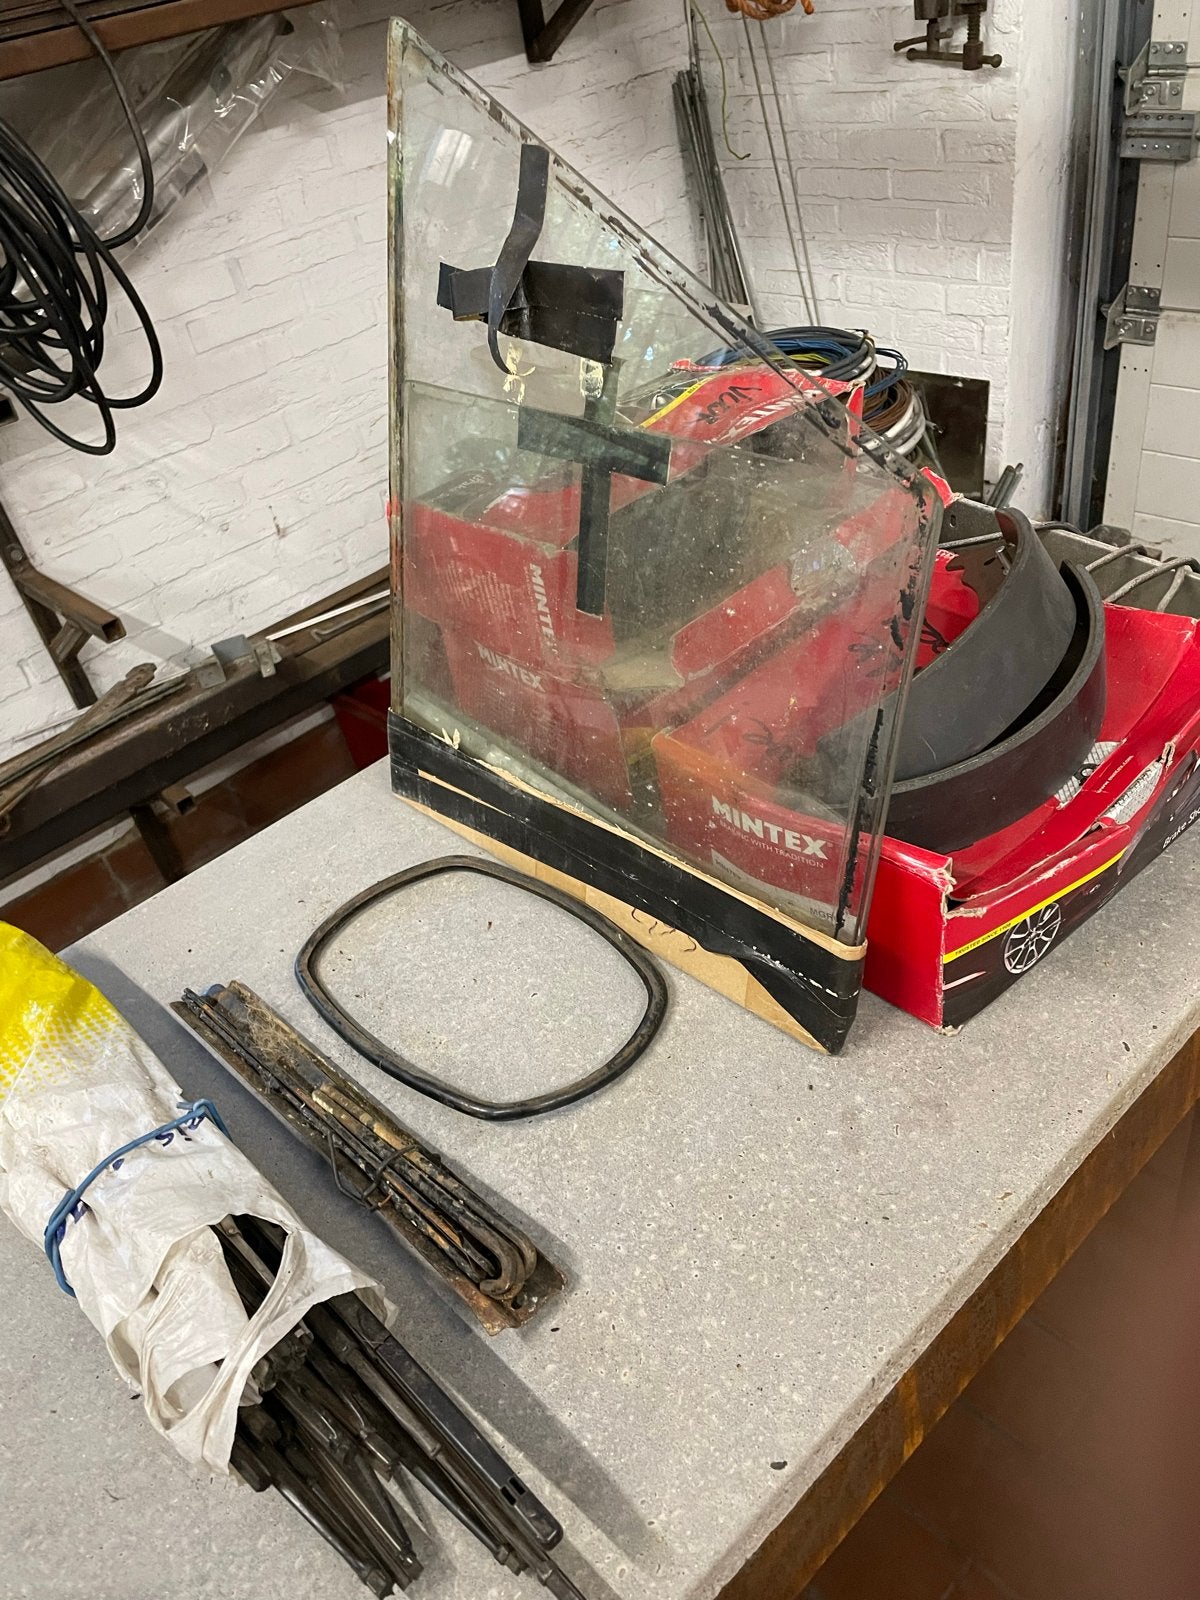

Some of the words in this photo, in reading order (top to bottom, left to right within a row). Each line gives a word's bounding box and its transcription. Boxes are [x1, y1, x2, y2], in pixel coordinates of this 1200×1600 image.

[473, 641, 546, 693] MINTEX
[711, 794, 828, 860] MINTEX
[1163, 822, 1187, 848] Brake
[750, 838, 774, 854] WITH
[773, 846, 825, 869] TRADITION
[809, 907, 837, 922] MGR
